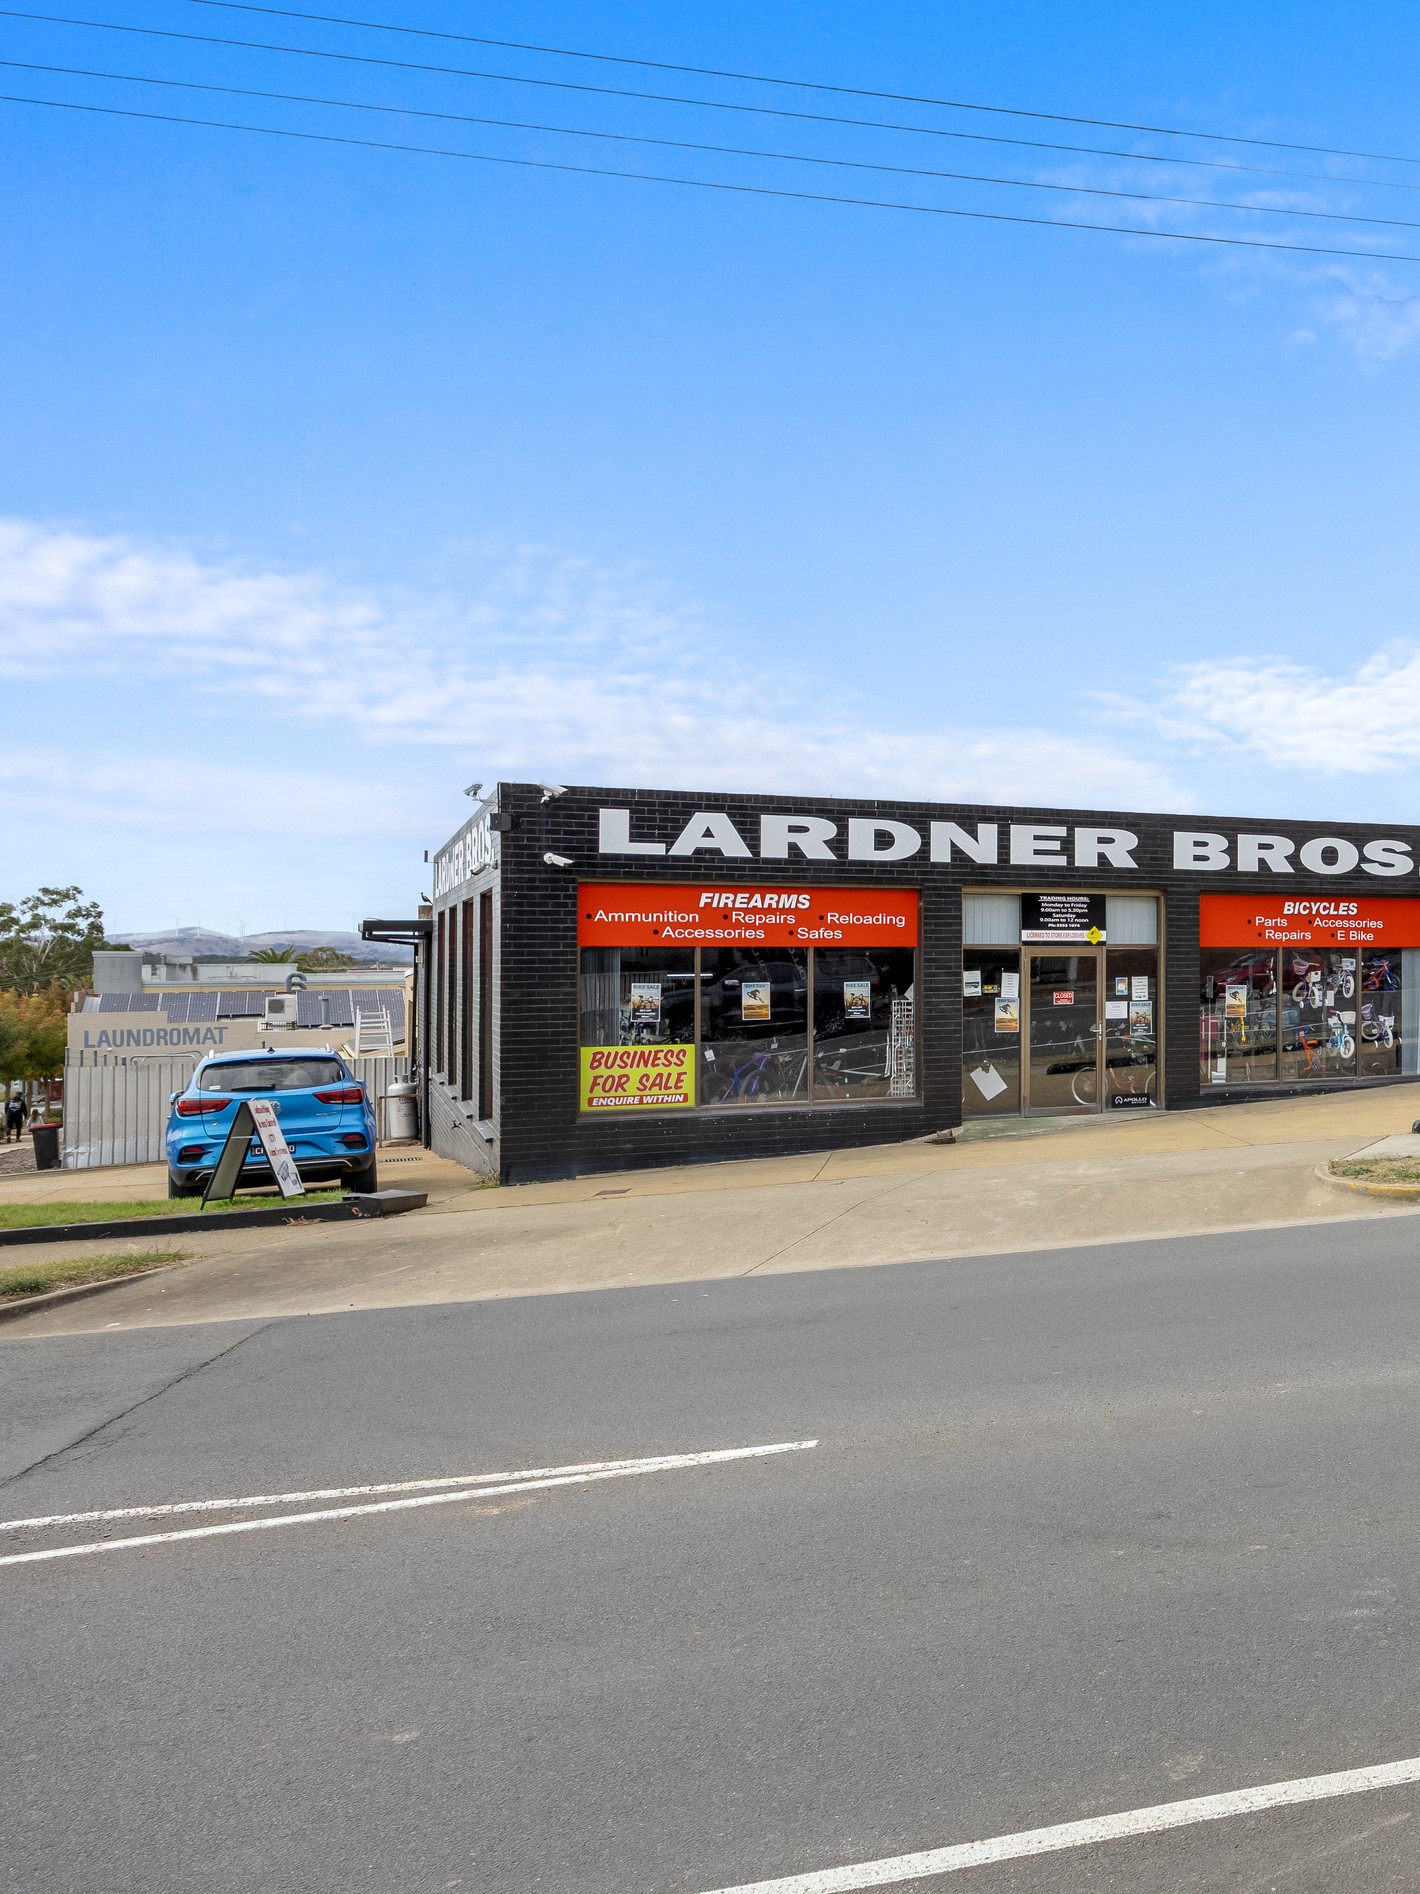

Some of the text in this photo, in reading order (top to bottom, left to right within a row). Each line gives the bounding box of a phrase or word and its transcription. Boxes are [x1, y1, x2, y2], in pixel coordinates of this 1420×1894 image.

[599, 807, 1139, 868] LARDNER
[699, 892, 811, 909] FIREARMS
[1283, 901, 1358, 915] BICYCLES
[594, 909, 906, 928] Ammunition Repairs Reloading
[1255, 916, 1383, 928] Parts Accessories
[661, 926, 843, 939] Accessories Safes
[1265, 929, 1374, 942] Repairs E Bike
[84, 1026, 229, 1049] LAUNDROMAT
[589, 1048, 687, 1071] BUSINESS
[589, 1071, 687, 1094] FOR SALE
[592, 1094, 684, 1106] ENQUIRE WITHIN
